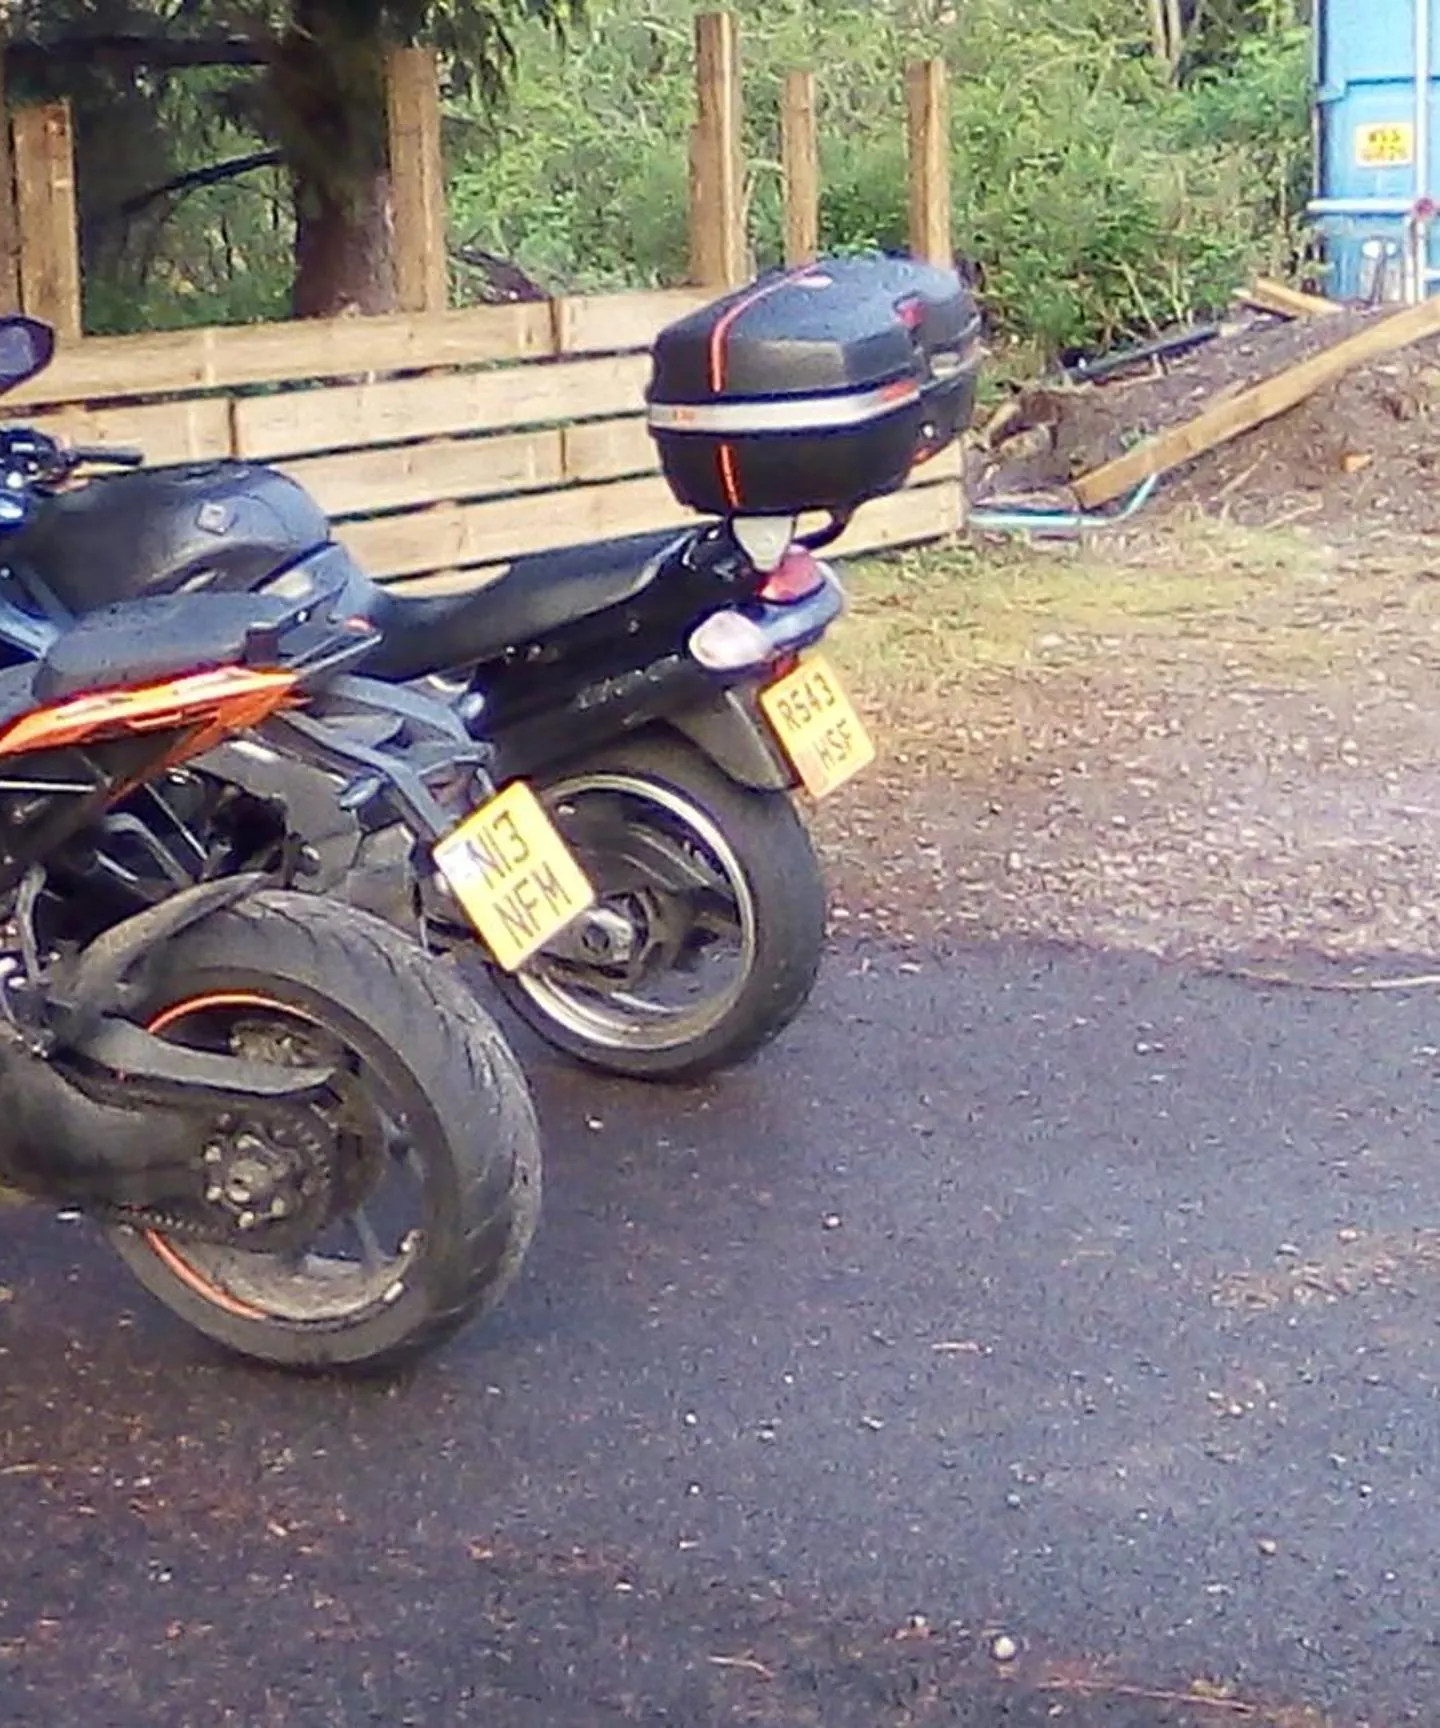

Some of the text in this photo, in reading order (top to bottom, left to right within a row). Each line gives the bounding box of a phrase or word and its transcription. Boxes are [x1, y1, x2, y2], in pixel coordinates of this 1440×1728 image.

[776, 671, 836, 731] R543
[465, 809, 530, 890] N13
[492, 860, 573, 950] NFM
